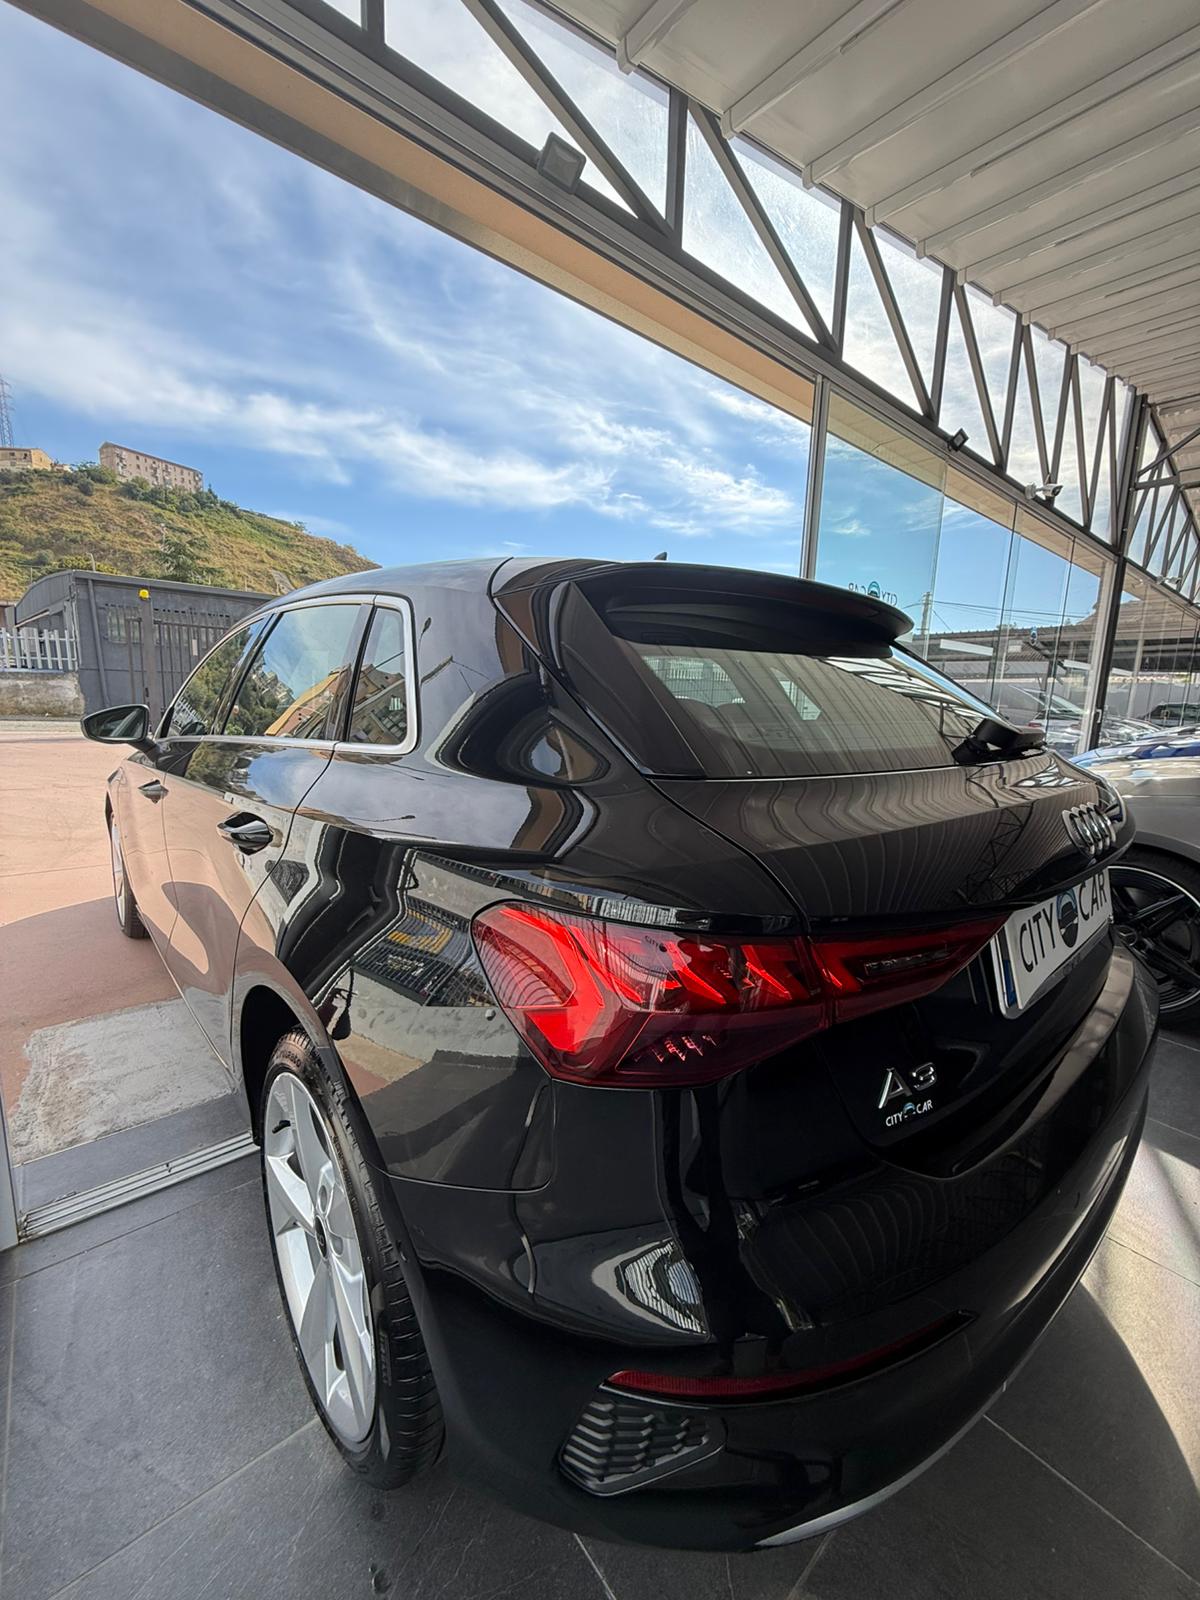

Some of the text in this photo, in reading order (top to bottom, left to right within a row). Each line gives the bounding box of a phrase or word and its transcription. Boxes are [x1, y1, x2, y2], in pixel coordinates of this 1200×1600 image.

[1019, 902, 1056, 973] CITY
[1078, 871, 1108, 921] CAR
[878, 1062, 938, 1109] A3
[885, 1099, 933, 1127] CITY CAR
